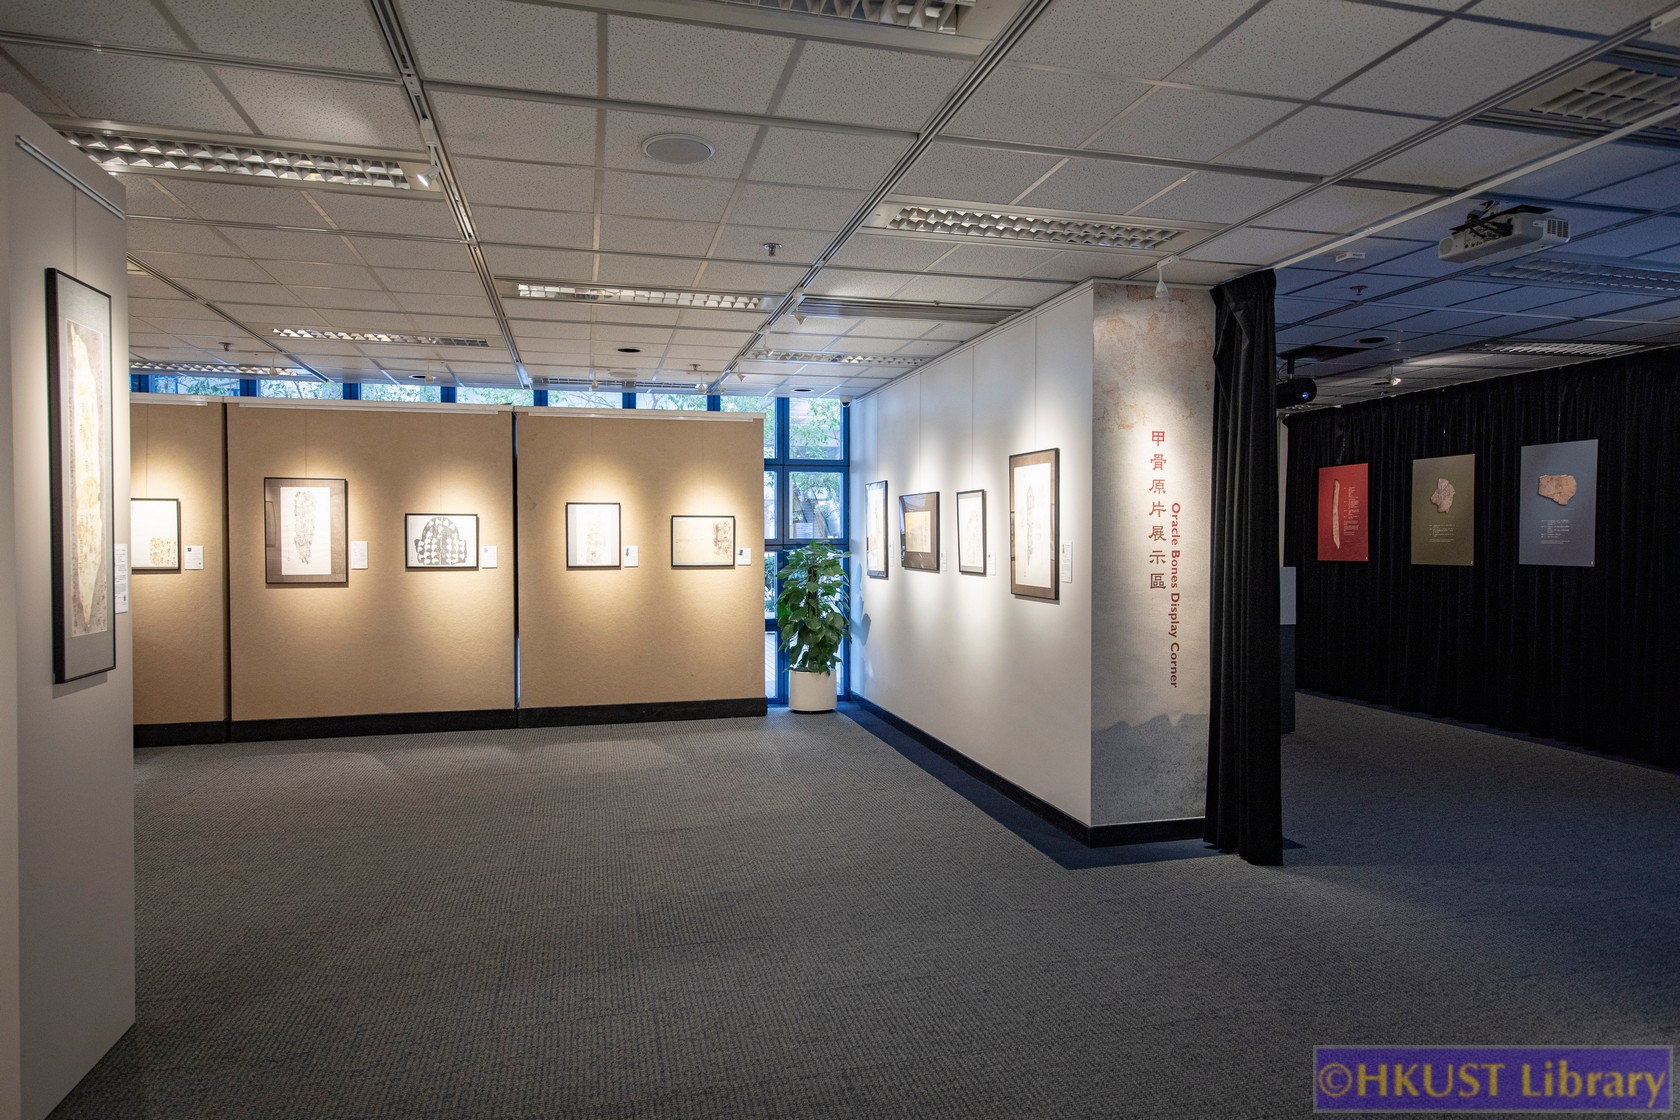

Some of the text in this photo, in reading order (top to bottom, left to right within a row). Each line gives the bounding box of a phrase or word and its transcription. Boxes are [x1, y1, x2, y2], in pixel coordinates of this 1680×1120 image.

[1148, 430, 1167, 590] 甲骨原片展示區
[1168, 502, 1181, 689] Oracle Bones Display Corner
